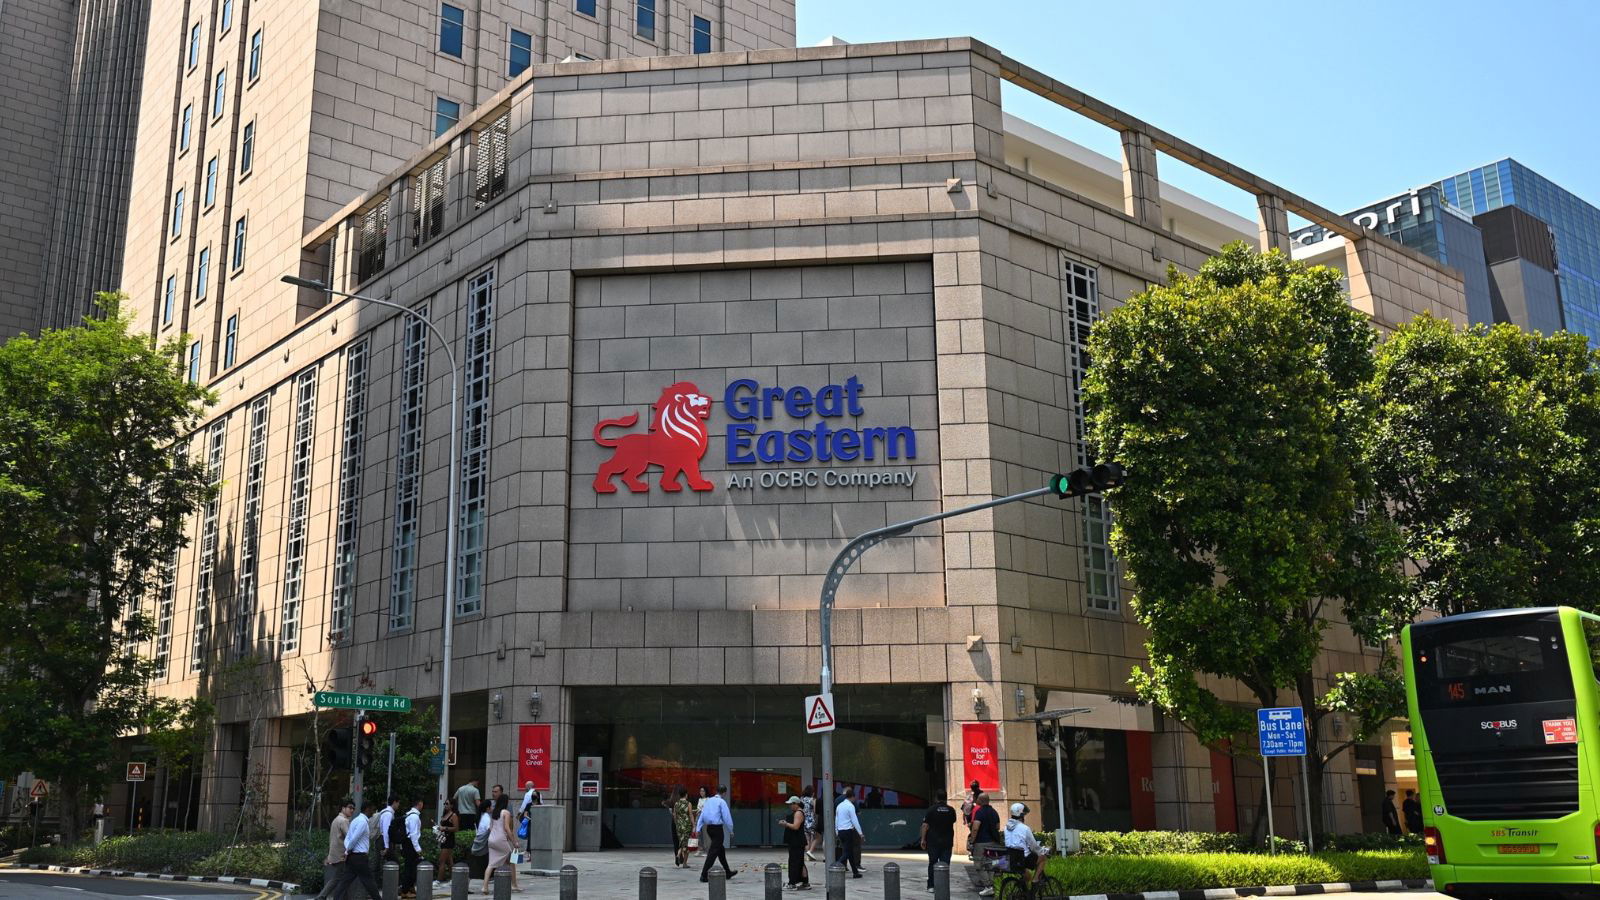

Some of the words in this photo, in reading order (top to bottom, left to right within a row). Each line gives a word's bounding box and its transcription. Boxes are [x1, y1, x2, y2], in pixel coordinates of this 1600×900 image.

[724, 374, 864, 421] Great
[727, 420, 916, 465] Eastern
[728, 473, 753, 489] An
[760, 471, 818, 488] OCBC
[824, 470, 917, 489] Company
[1448, 683, 1464, 699] 145
[1474, 685, 1511, 694] MAN
[320, 693, 352, 705] South
[355, 695, 389, 708] Bridge
[393, 698, 405, 708] Rd
[1260, 720, 1277, 731] Bus
[1279, 720, 1302, 730] Lane
[1504, 827, 1538, 837] Transit
